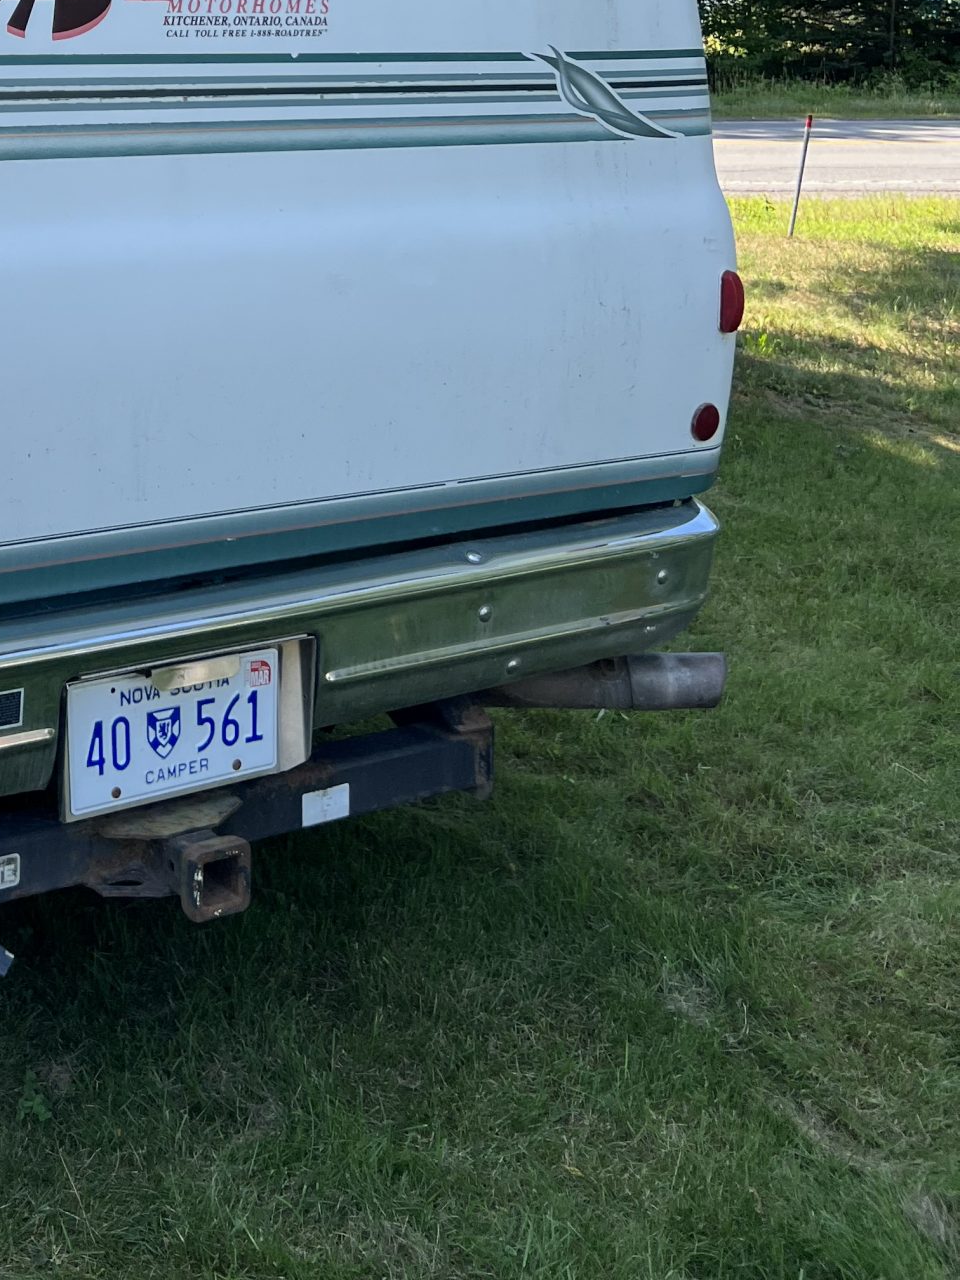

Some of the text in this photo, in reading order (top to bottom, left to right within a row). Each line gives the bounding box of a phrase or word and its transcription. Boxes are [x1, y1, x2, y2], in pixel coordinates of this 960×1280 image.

[163, 15, 328, 28] KITCHENER, ONTARIO, CANADA
[195, 29, 219, 38] TOLL
[222, 29, 247, 37] FREE
[250, 670, 270, 687] MAR
[120, 685, 160, 706] NOVA
[86, 690, 263, 776] 40 561
[145, 757, 210, 785] CAMPER
